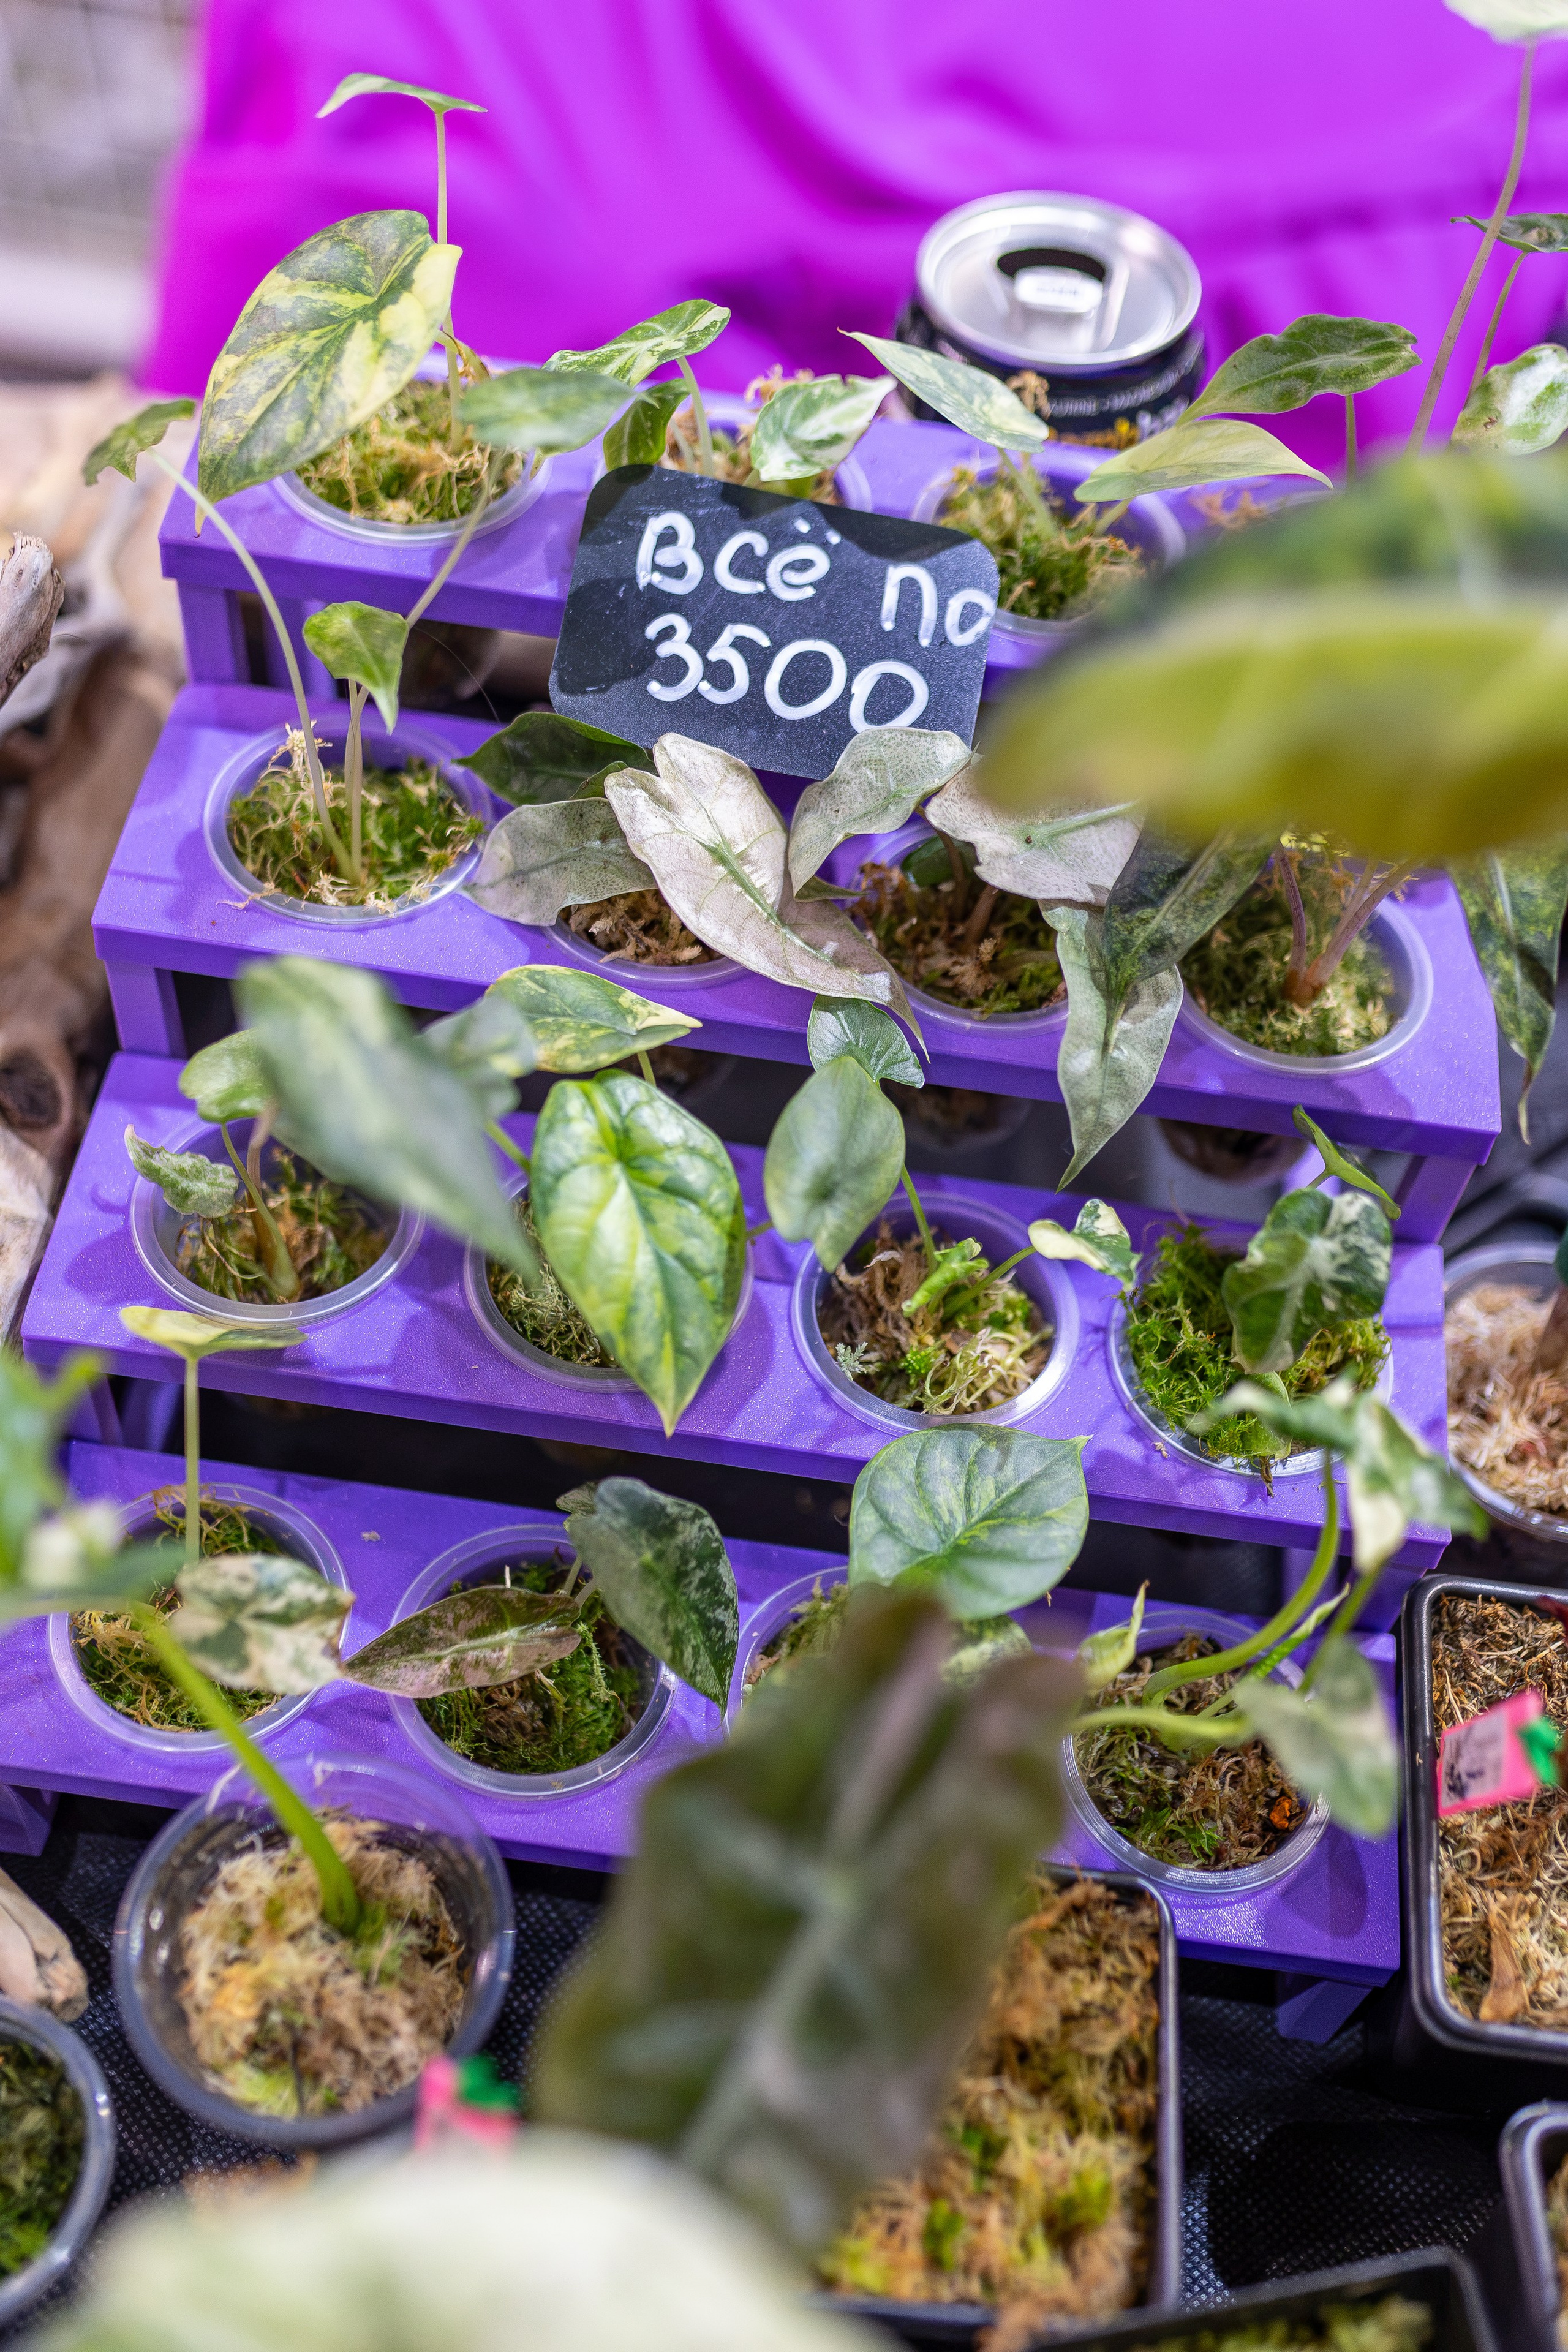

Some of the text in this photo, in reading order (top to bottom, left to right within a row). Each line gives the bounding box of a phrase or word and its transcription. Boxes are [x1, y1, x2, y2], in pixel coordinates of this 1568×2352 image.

[636, 511, 996, 648] Всё по
[644, 612, 929, 733] 3500
